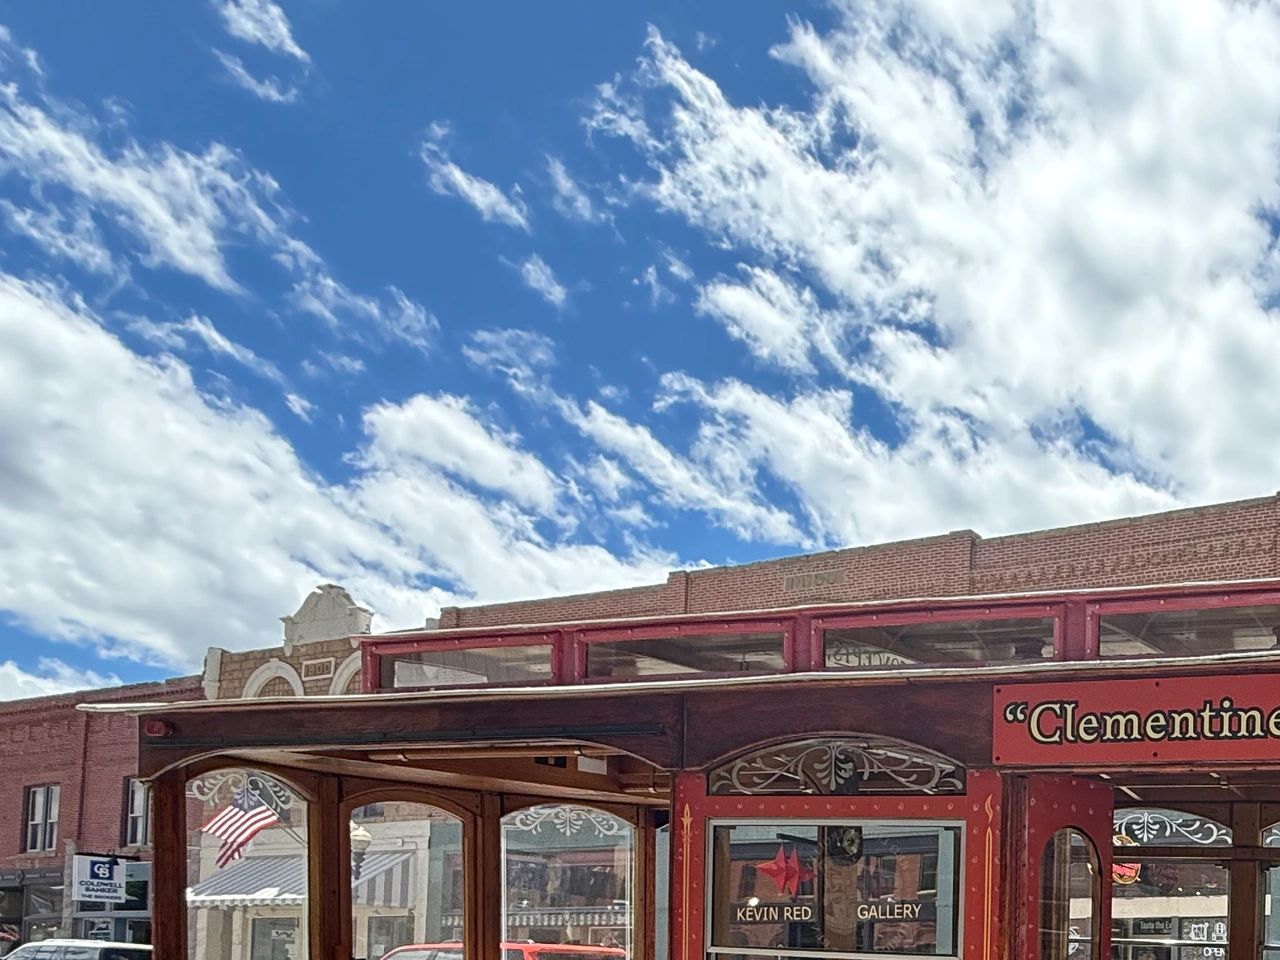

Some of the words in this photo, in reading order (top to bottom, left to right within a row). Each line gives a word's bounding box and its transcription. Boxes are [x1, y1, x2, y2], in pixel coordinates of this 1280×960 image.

[79, 880, 123, 889] COLDWELL
[85, 886, 118, 894] BANKER
[737, 905, 779, 921] KEVIN
[784, 905, 812, 921] RED
[857, 903, 922, 919] GALLERY
